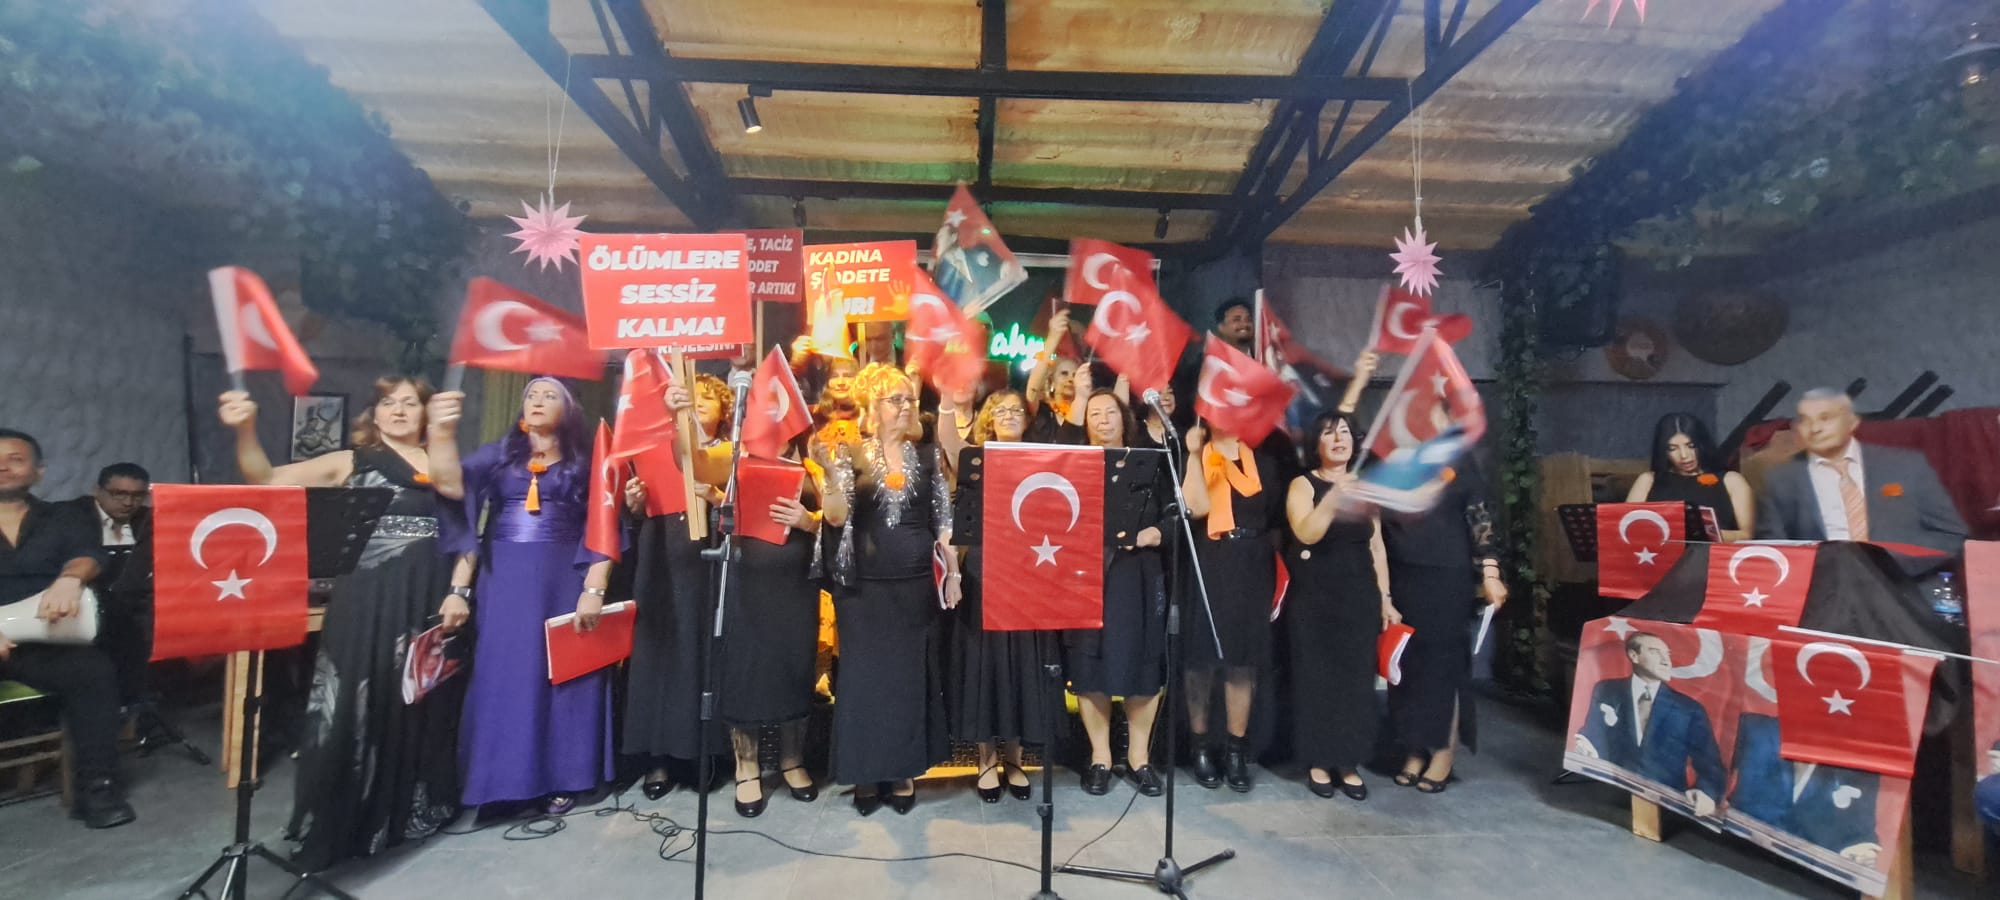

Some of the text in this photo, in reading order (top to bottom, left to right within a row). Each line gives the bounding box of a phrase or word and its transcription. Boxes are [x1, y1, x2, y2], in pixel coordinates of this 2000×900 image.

[760, 234, 794, 251] TACİZ
[587, 244, 742, 271] ÖLÜMLERE
[748, 259, 780, 273] DDET
[809, 248, 883, 267] KADINA
[620, 277, 718, 305] SESSİZ
[616, 316, 727, 339] KALMA!
